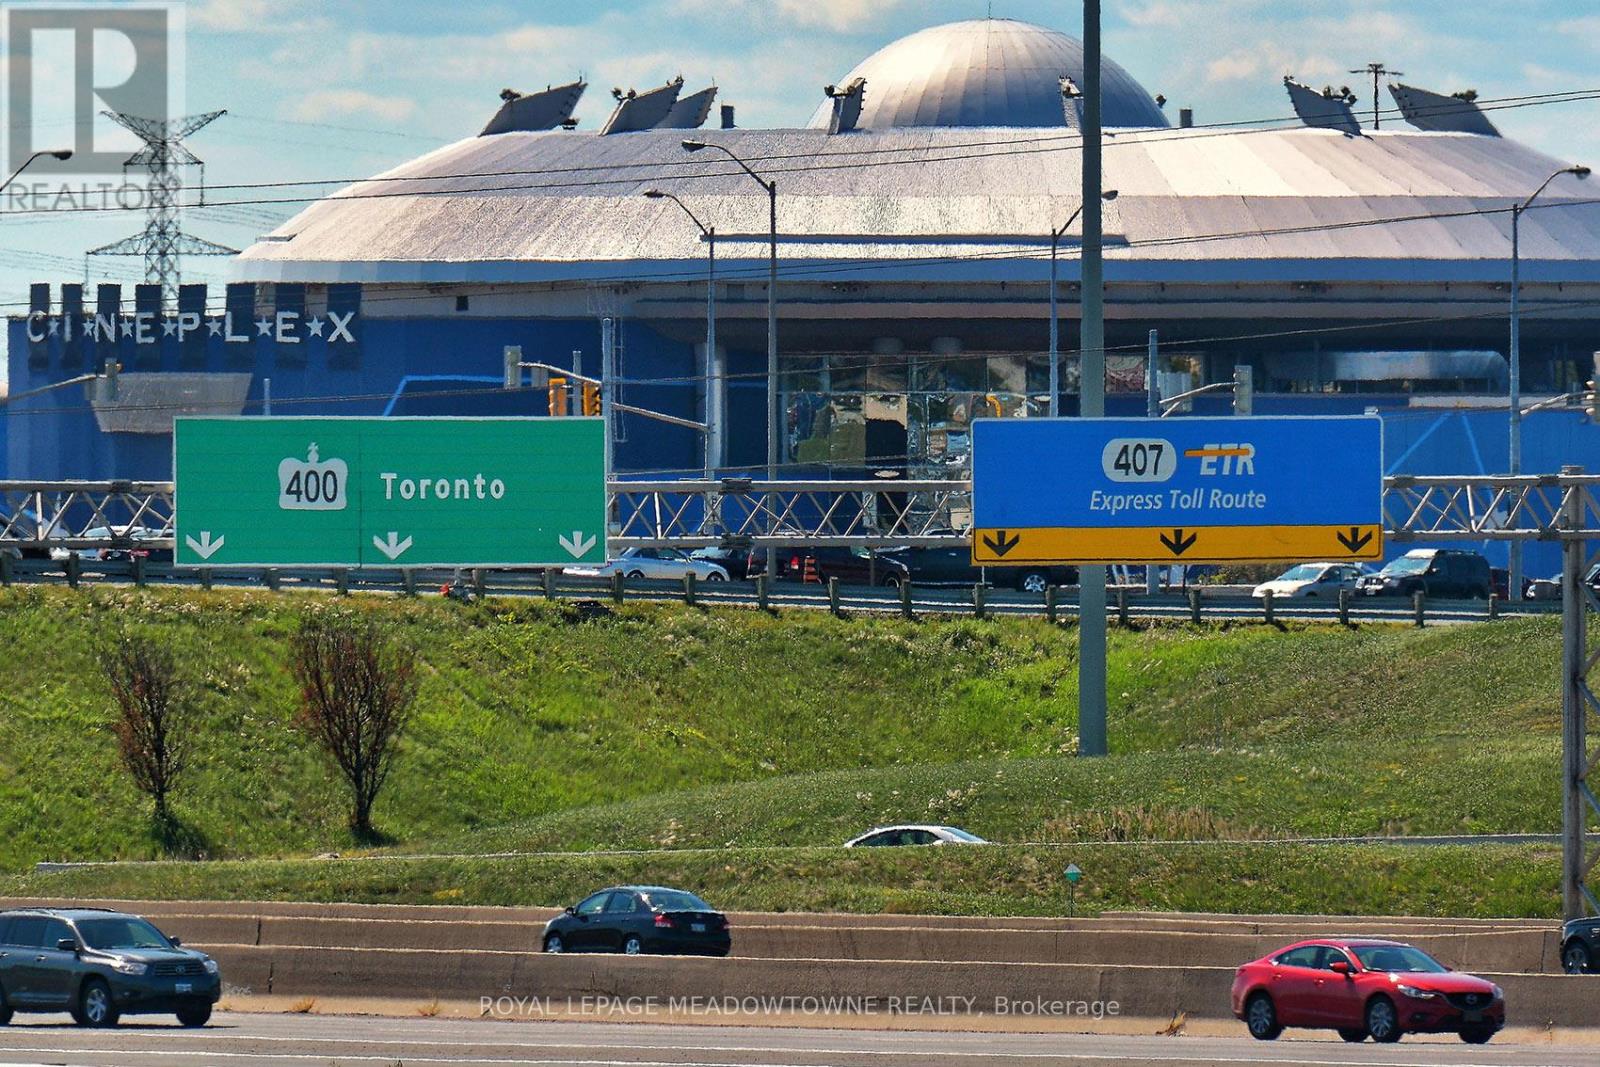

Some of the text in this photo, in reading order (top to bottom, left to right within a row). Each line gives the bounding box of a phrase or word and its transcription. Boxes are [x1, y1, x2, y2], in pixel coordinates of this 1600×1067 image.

[1113, 442, 1256, 476] 407 ETR
[285, 469, 339, 503] 400
[380, 472, 506, 500] Toronto
[1089, 488, 1267, 515] Express Toll Route
